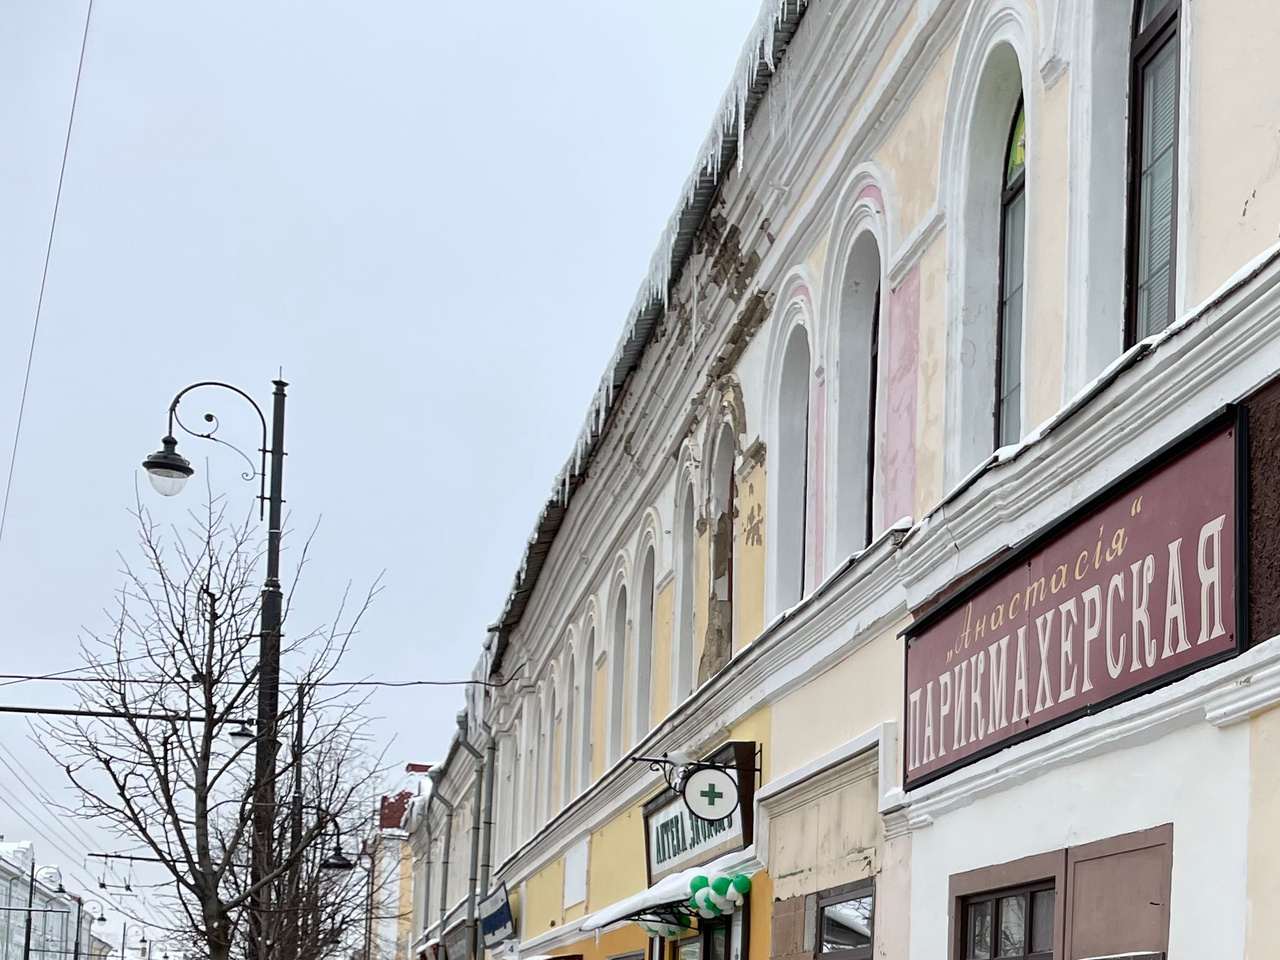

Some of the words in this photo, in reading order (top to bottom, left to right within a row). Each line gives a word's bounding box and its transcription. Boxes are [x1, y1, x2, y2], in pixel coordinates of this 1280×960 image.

[907, 513, 1227, 772] ПАРИКМАХЕРСКАЯ
[656, 811, 688, 865] АПТЕКА
[508, 945, 515, 954] 4
